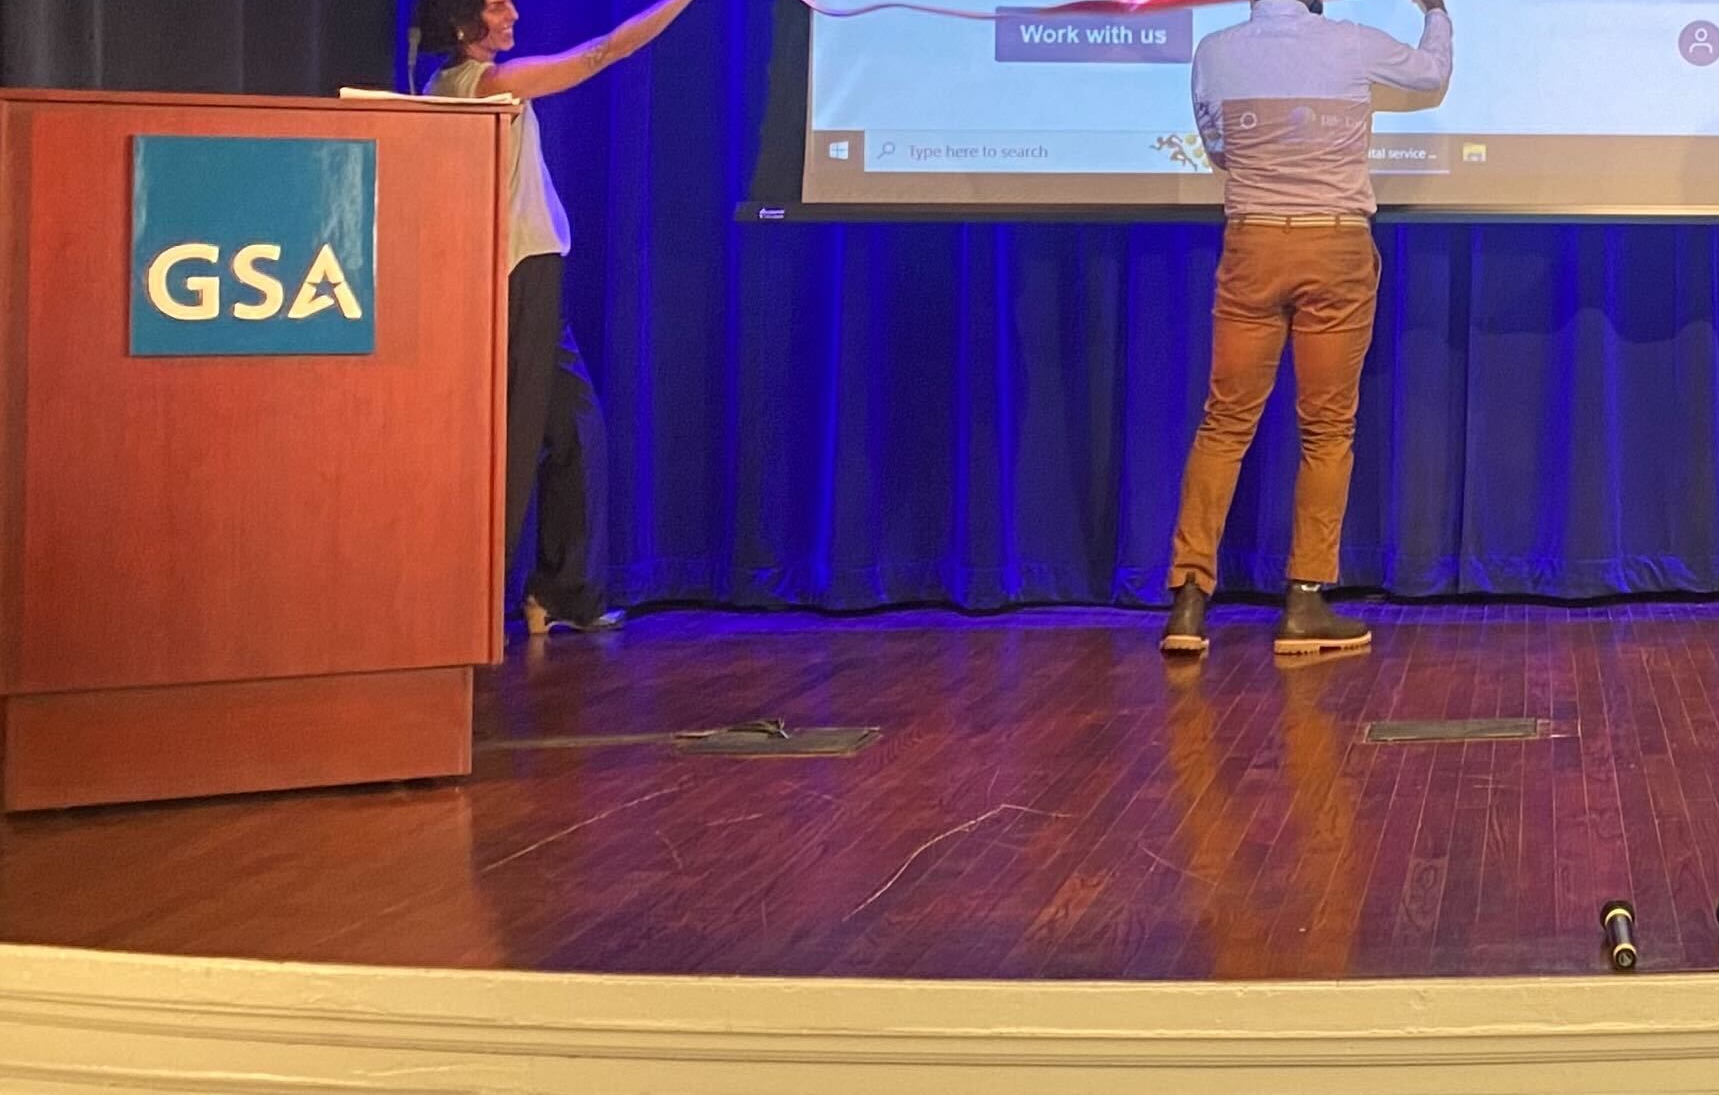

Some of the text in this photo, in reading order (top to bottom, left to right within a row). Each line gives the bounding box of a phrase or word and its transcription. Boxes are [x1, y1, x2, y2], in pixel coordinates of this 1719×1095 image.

[1020, 25, 1166, 44] Work with us
[909, 145, 1048, 161] Type here to search
[1388, 148, 1426, 159] service
[147, 242, 362, 321] GSA
